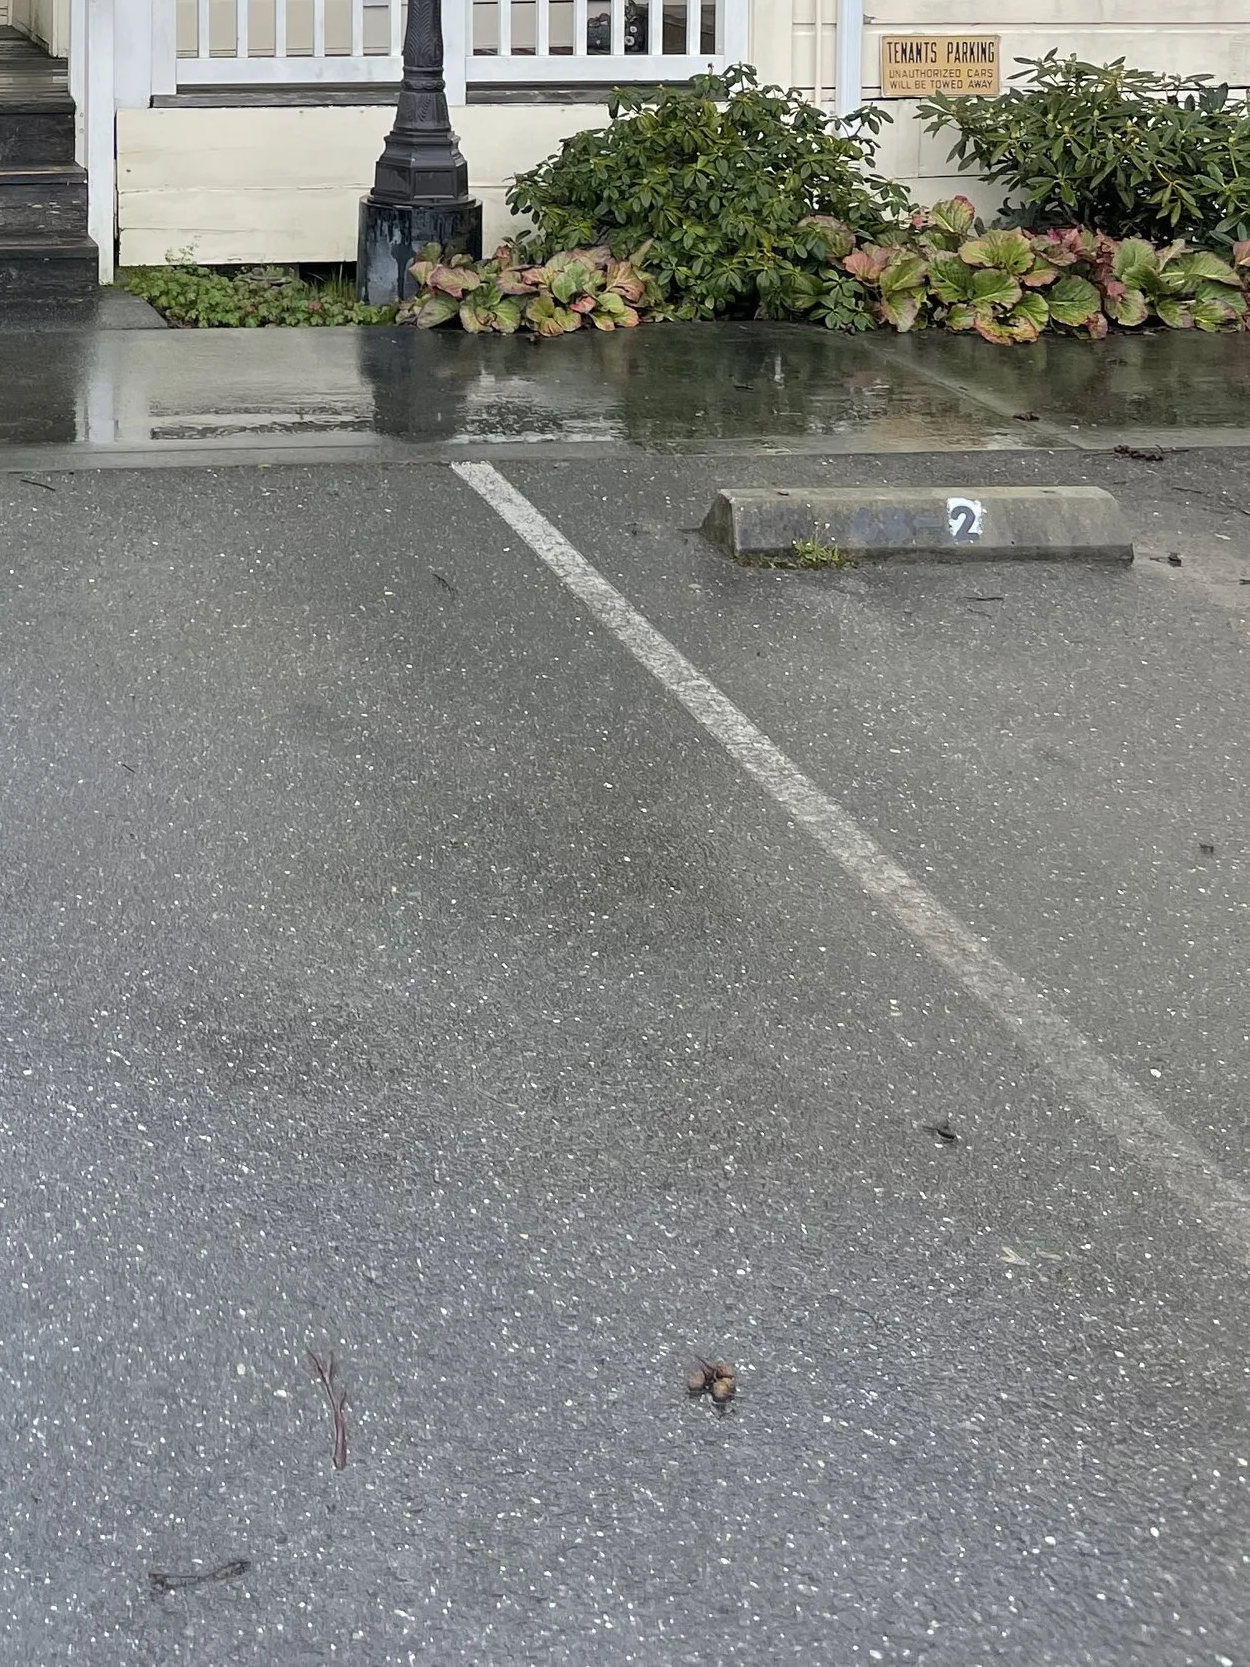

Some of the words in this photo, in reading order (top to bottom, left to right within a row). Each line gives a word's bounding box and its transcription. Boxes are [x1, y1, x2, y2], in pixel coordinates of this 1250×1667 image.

[886, 41, 937, 64] TENANTS
[947, 41, 995, 64] PARKING
[889, 68, 961, 79] UNAUTHORIZED
[966, 68, 994, 78] CARS
[890, 80, 911, 90] WILL
[914, 79, 927, 90] BE
[930, 79, 963, 89] TOWED
[968, 79, 993, 89] AWAY
[950, 505, 980, 541] 2
